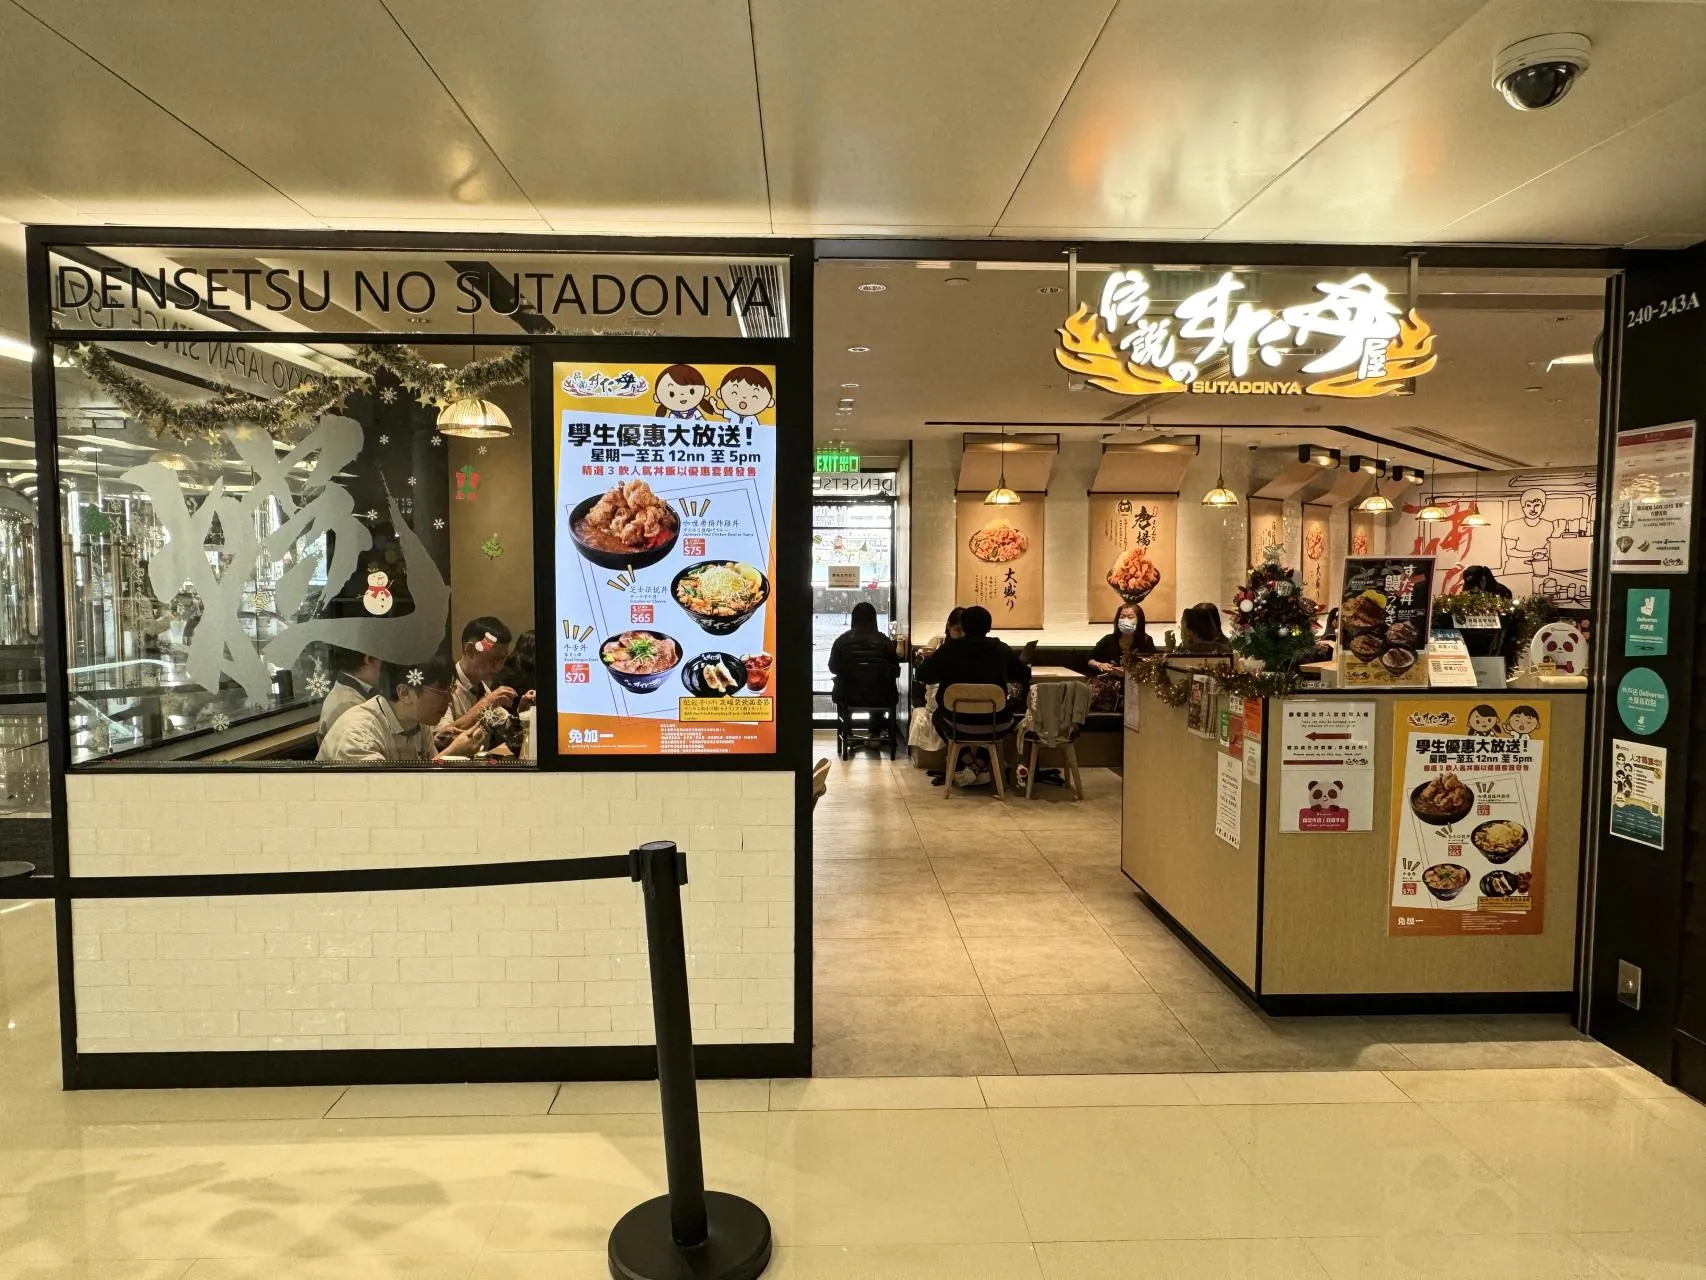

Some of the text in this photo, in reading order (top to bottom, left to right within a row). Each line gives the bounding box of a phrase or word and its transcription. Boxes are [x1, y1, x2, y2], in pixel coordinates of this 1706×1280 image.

[58, 265, 777, 318] DENSETSU NO SUTADONYA
[1627, 291, 1700, 328] 240-243A
[1191, 380, 1302, 395] SUTADONYA
[590, 448, 761, 465] 星期一至五 12nn 至 5pm
[816, 455, 859, 472] EXIT 出口
[608, 466, 614, 475] 3
[684, 546, 702, 555] $75
[1003, 567, 1017, 611] 大盛り
[1400, 564, 1417, 605] すた丼
[632, 613, 651, 623] $65
[566, 672, 586, 682] $70
[568, 728, 614, 743] 免加一
[1429, 754, 1532, 764] 星期一至五 12nn 至 5pm
